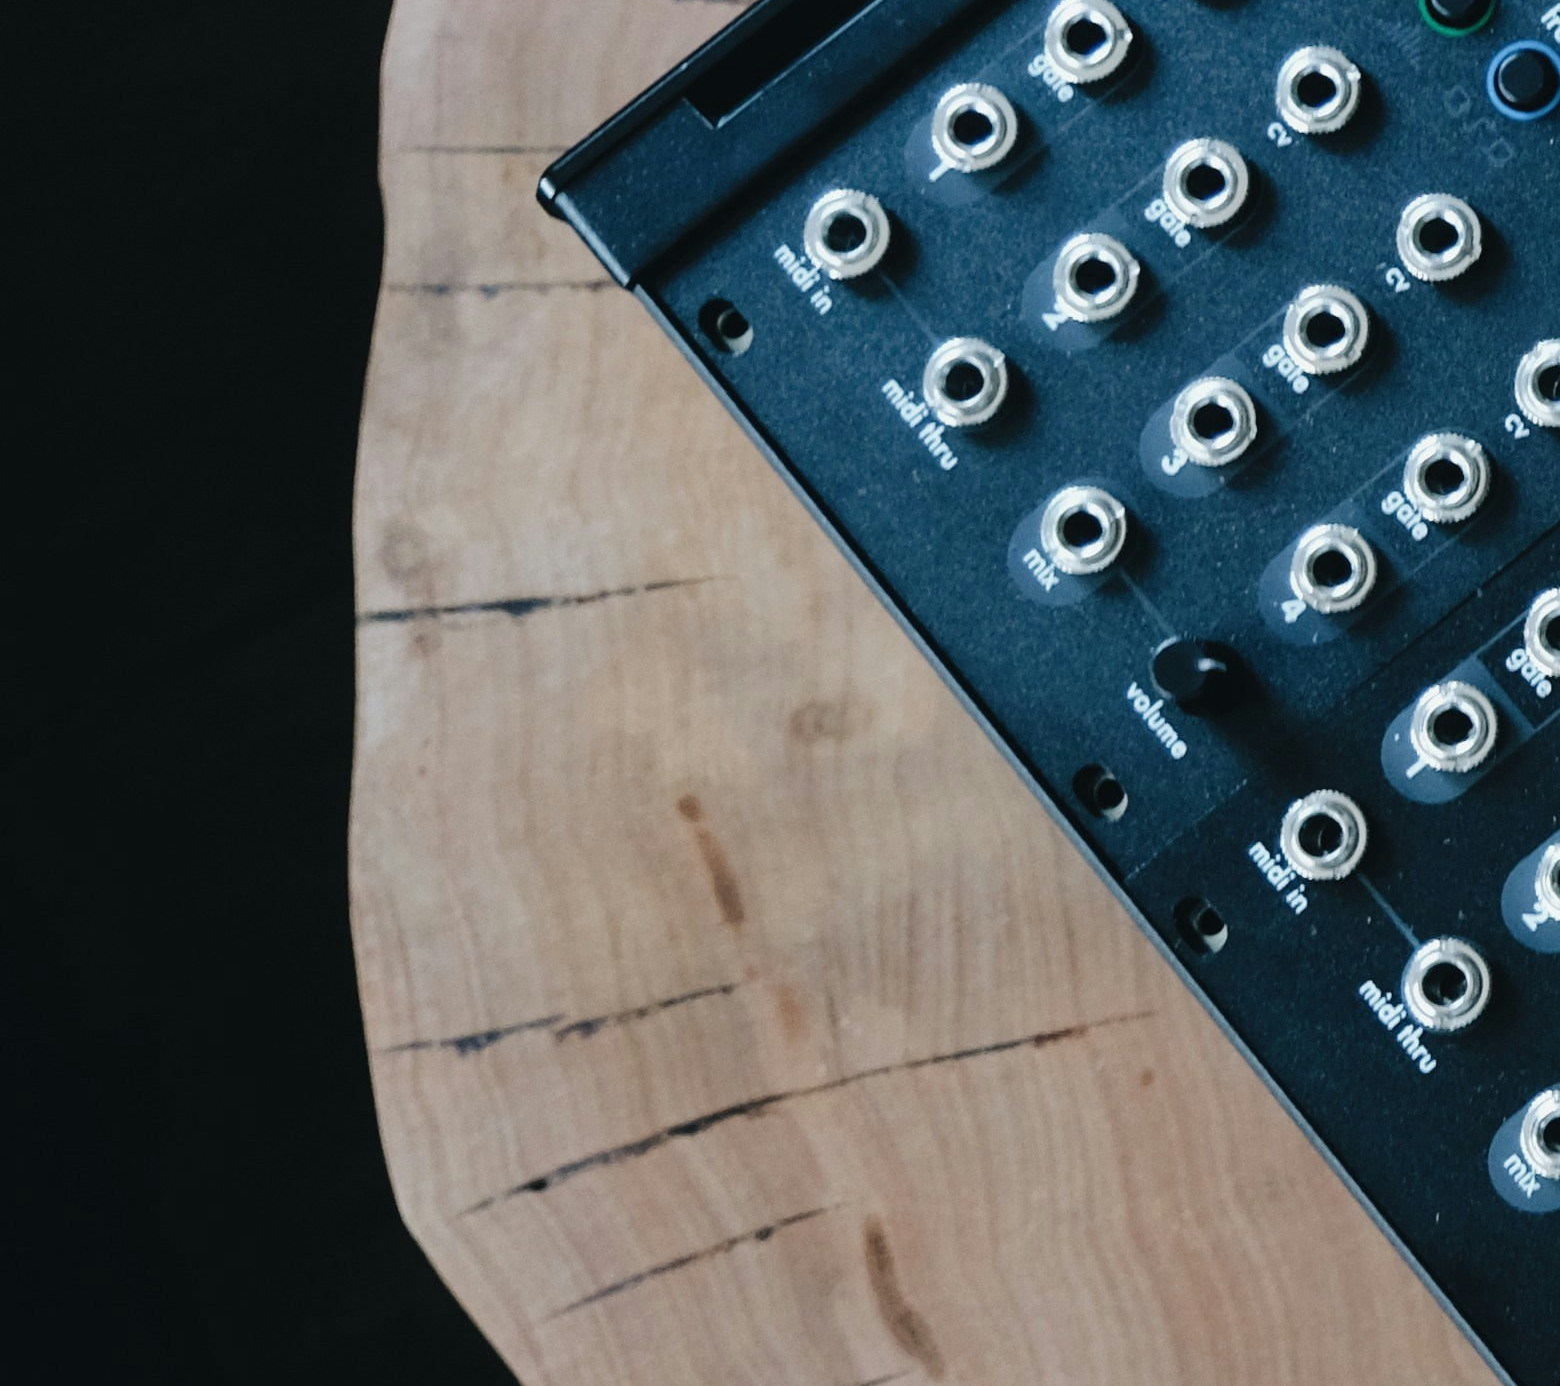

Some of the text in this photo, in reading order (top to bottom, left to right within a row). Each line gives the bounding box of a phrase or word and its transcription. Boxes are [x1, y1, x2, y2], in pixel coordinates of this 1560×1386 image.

[771, 242, 834, 317] midi in
[879, 377, 959, 472] midi thru
[1124, 680, 1189, 761] volume
